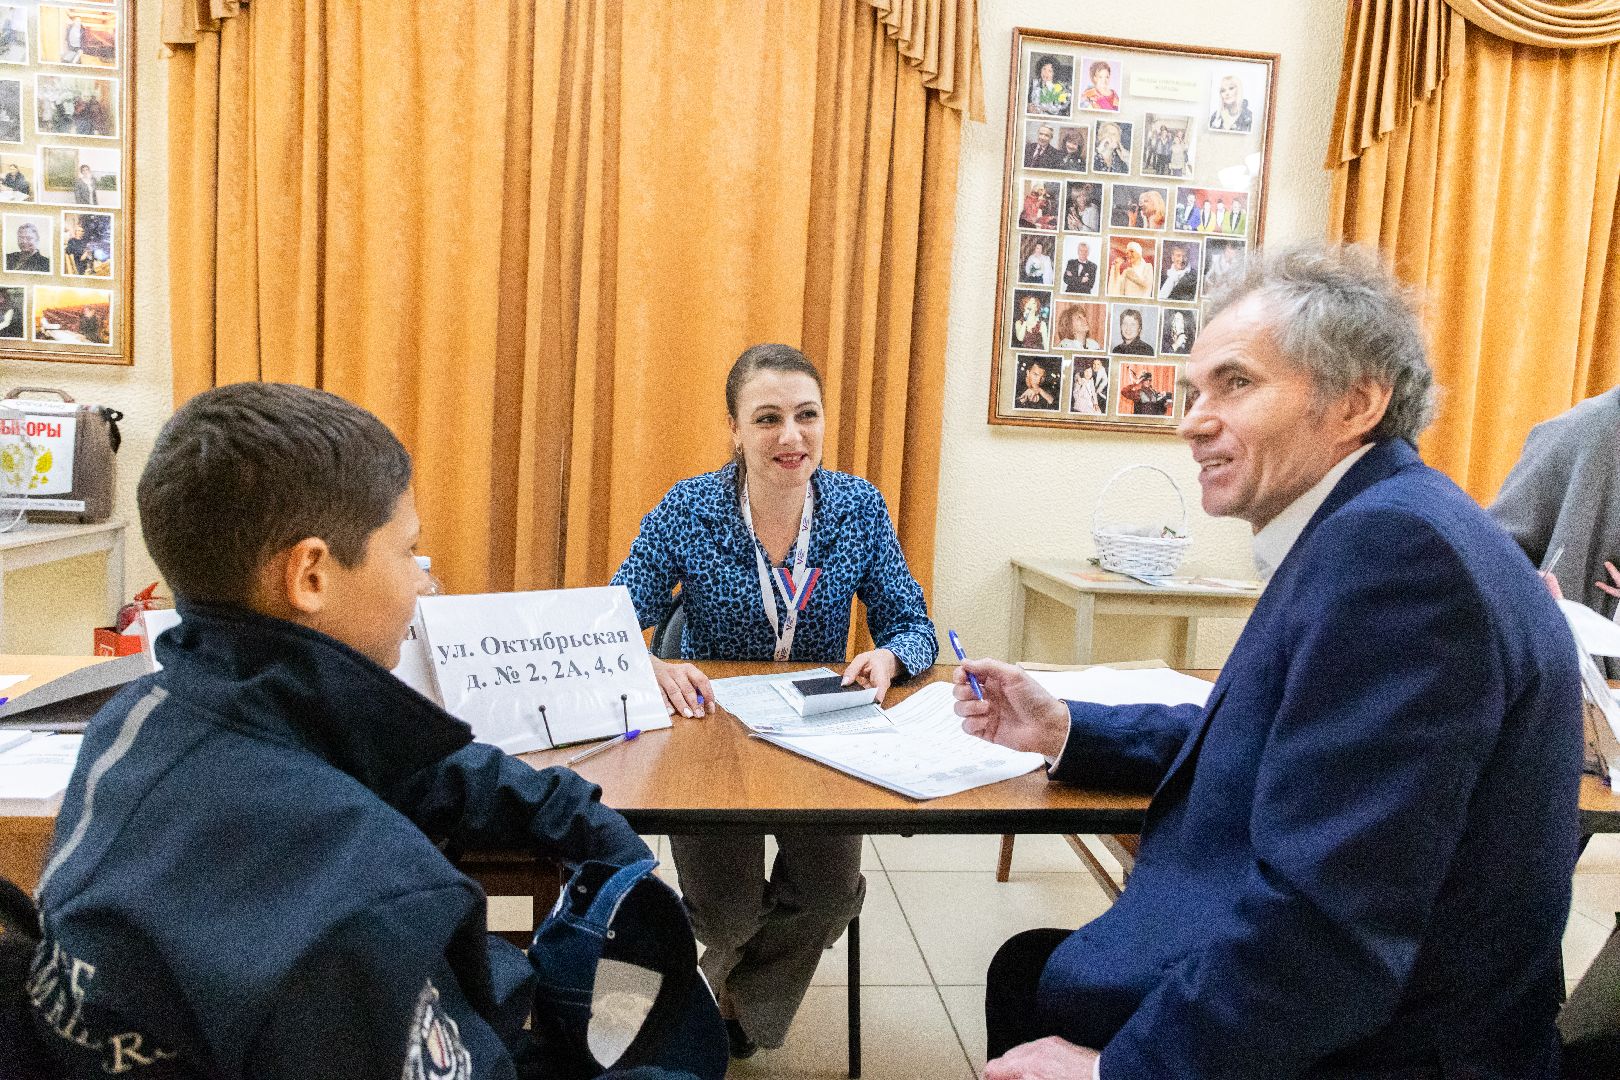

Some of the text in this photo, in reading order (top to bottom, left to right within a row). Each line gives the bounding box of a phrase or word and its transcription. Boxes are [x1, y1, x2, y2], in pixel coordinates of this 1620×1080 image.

[436, 630, 629, 665] ул. Октябрьская
[467, 653, 629, 692] д. № 2, 2А, 4, 6
